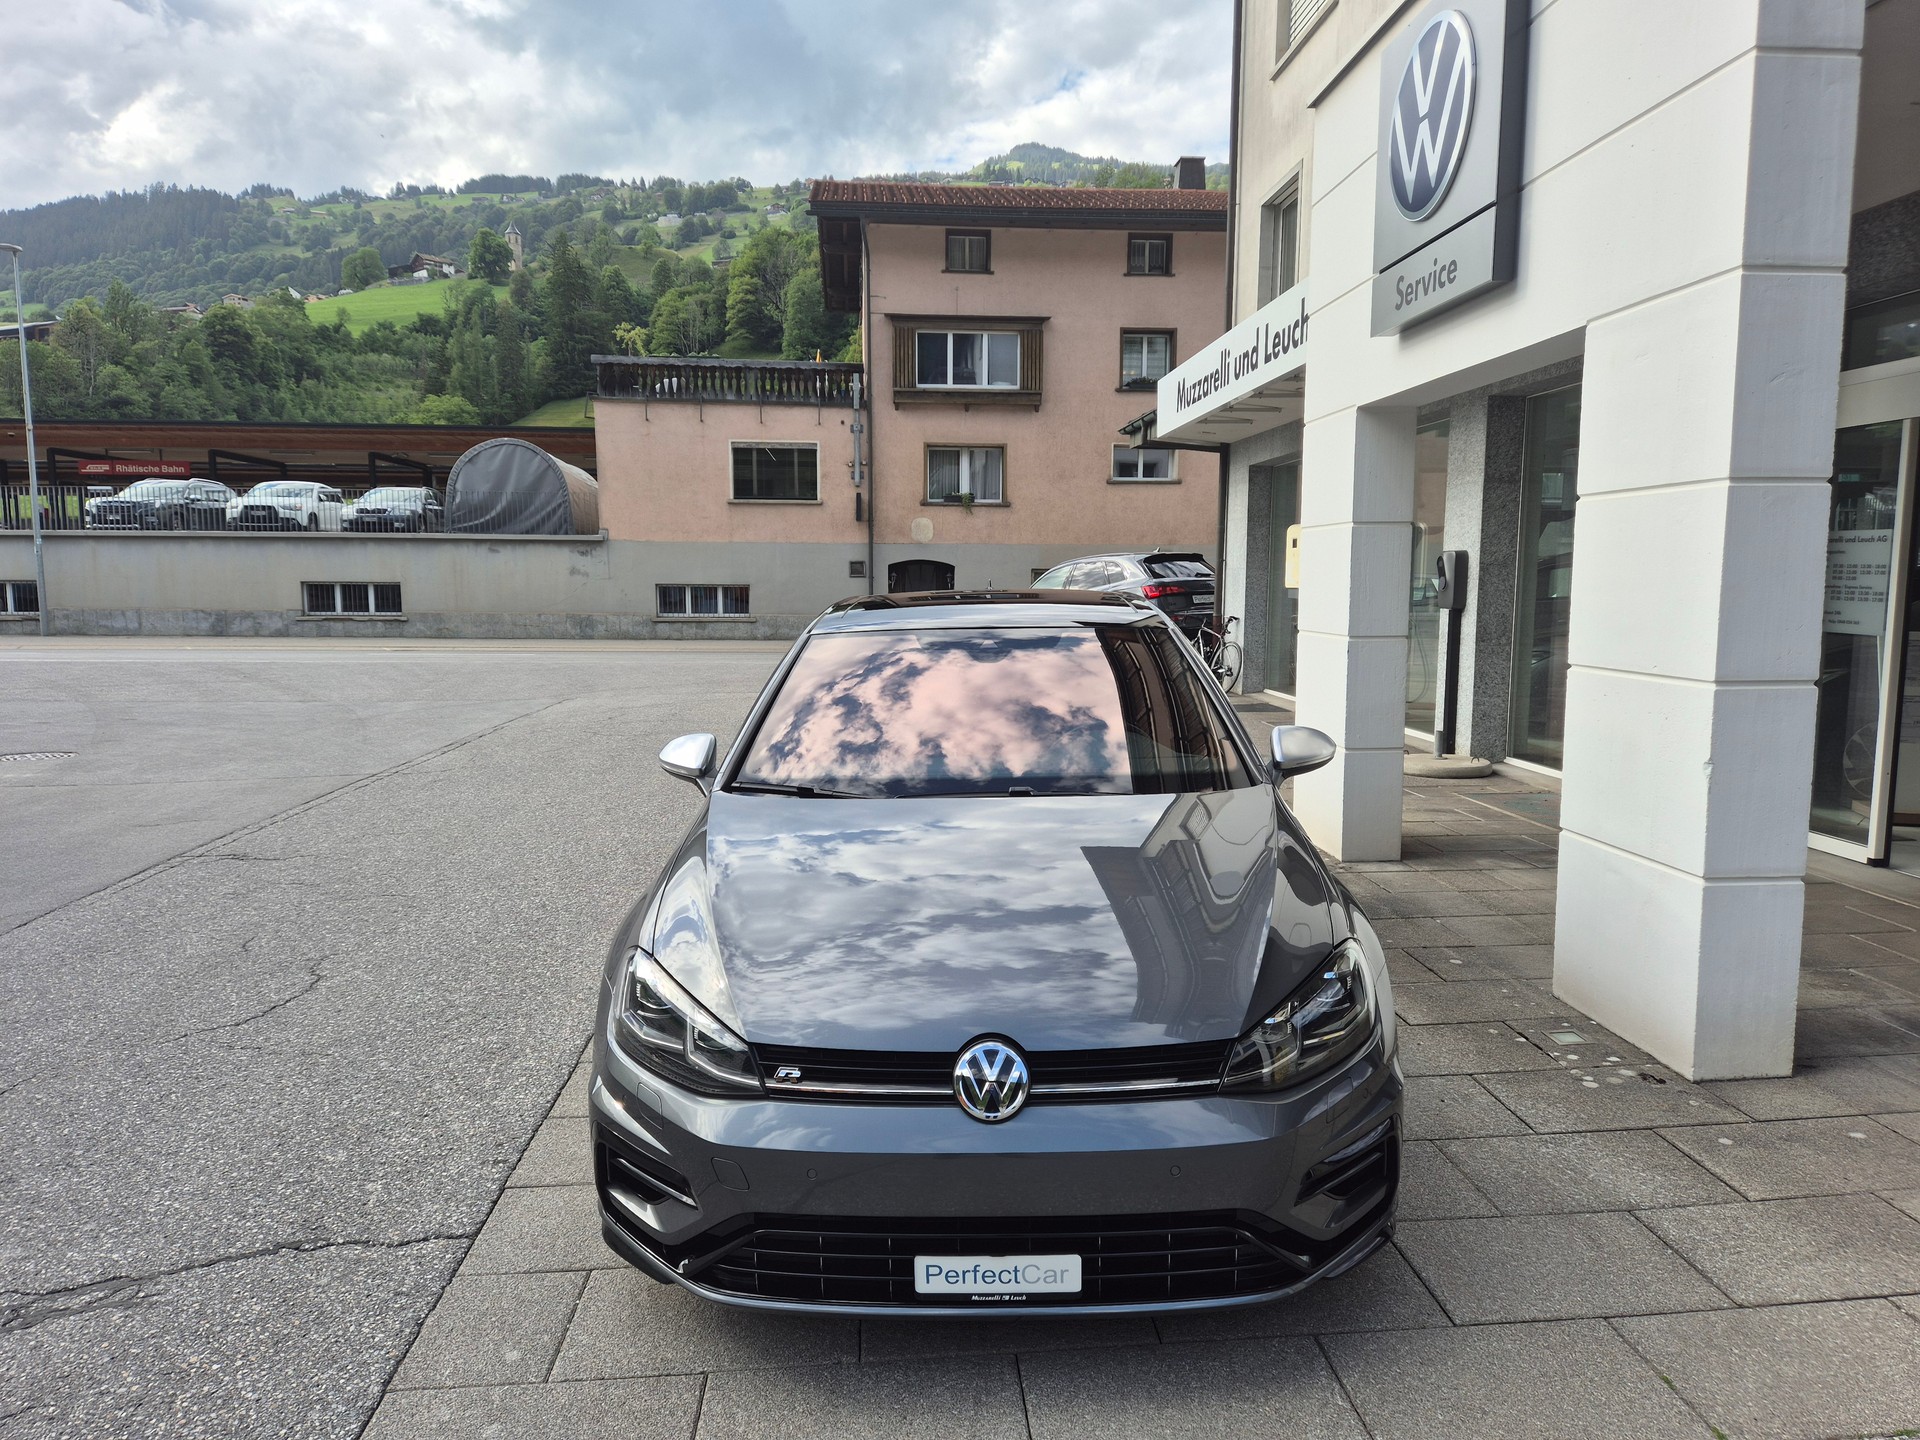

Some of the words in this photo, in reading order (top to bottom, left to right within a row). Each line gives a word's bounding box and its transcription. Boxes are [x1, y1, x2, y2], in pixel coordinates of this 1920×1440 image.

[1395, 258, 1458, 311] Service
[1176, 348, 1230, 413] Muzzarelli
[1234, 329, 1259, 381] und
[1264, 297, 1309, 365] Leuch
[115, 464, 160, 473] Rhätische
[161, 464, 185, 473] Bahn
[1876, 534, 1888, 543] AG
[774, 1066, 801, 1084] R
[925, 1264, 1070, 1285] PerfectCar
